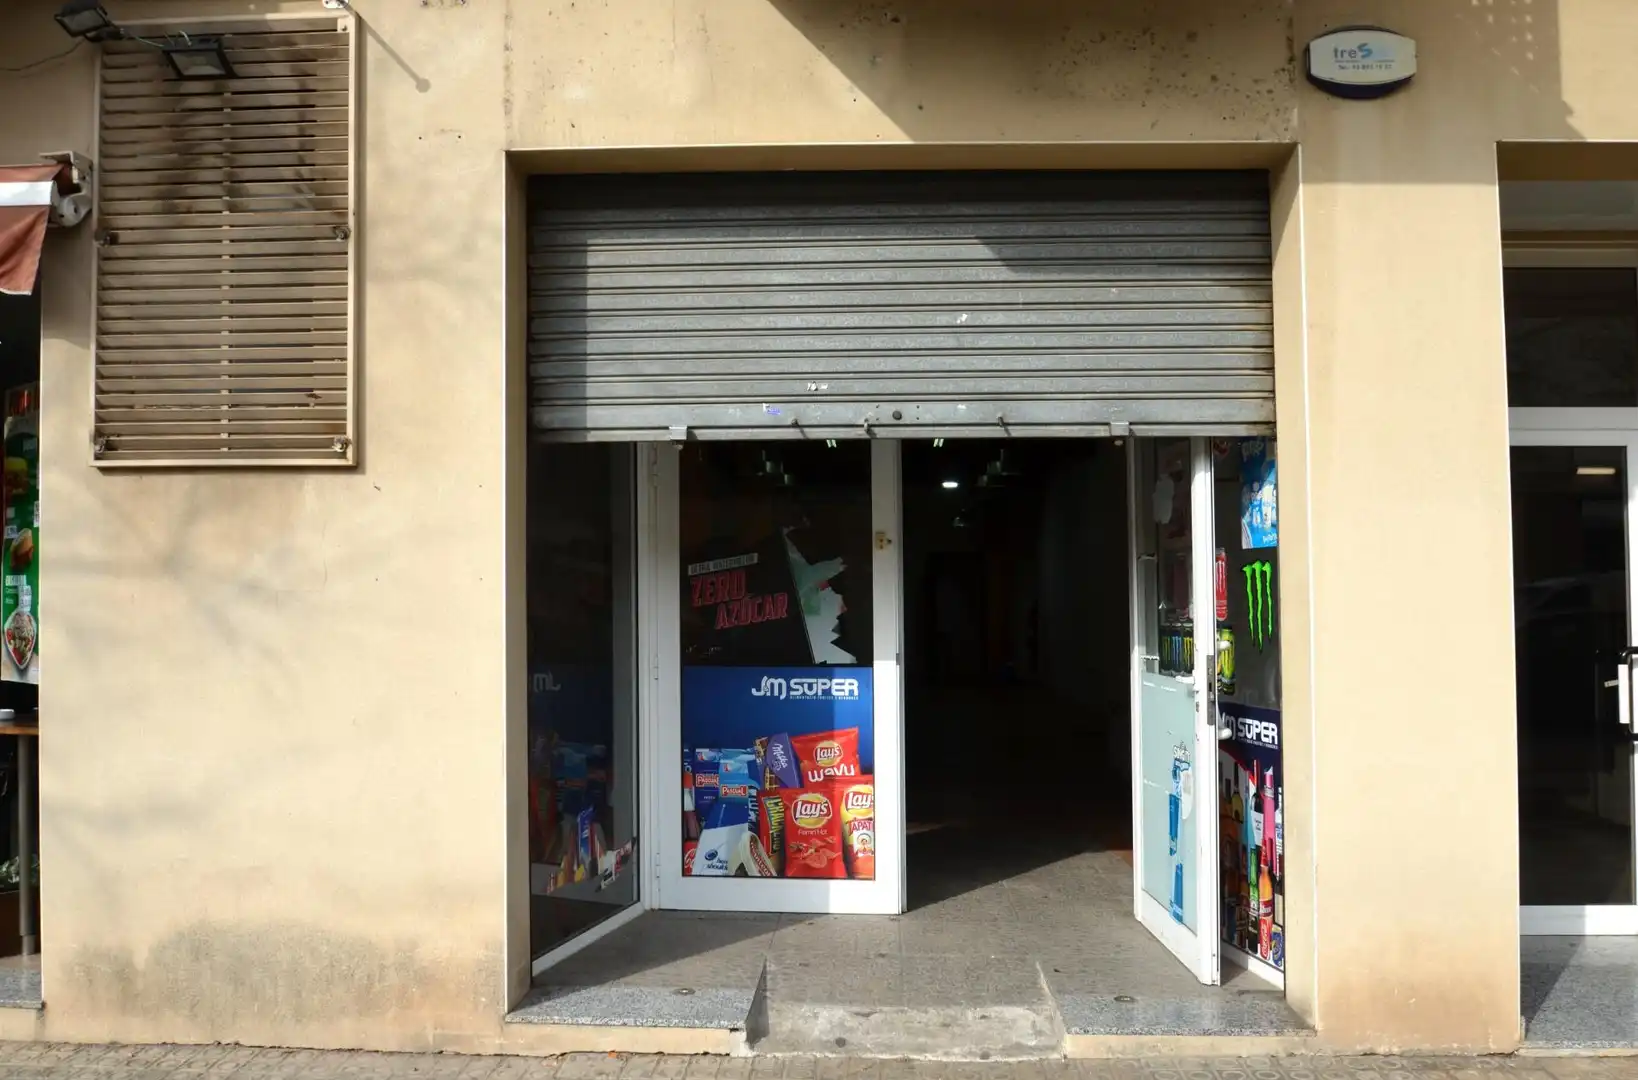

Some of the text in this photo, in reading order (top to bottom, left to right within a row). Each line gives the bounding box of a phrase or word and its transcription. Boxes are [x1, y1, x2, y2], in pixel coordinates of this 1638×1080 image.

[690, 569, 746, 607] ZERO
[789, 678, 859, 696] SUPER
[1237, 717, 1279, 745] SUPER
[816, 746, 840, 761] Lay's
[795, 799, 830, 819] Lay's
